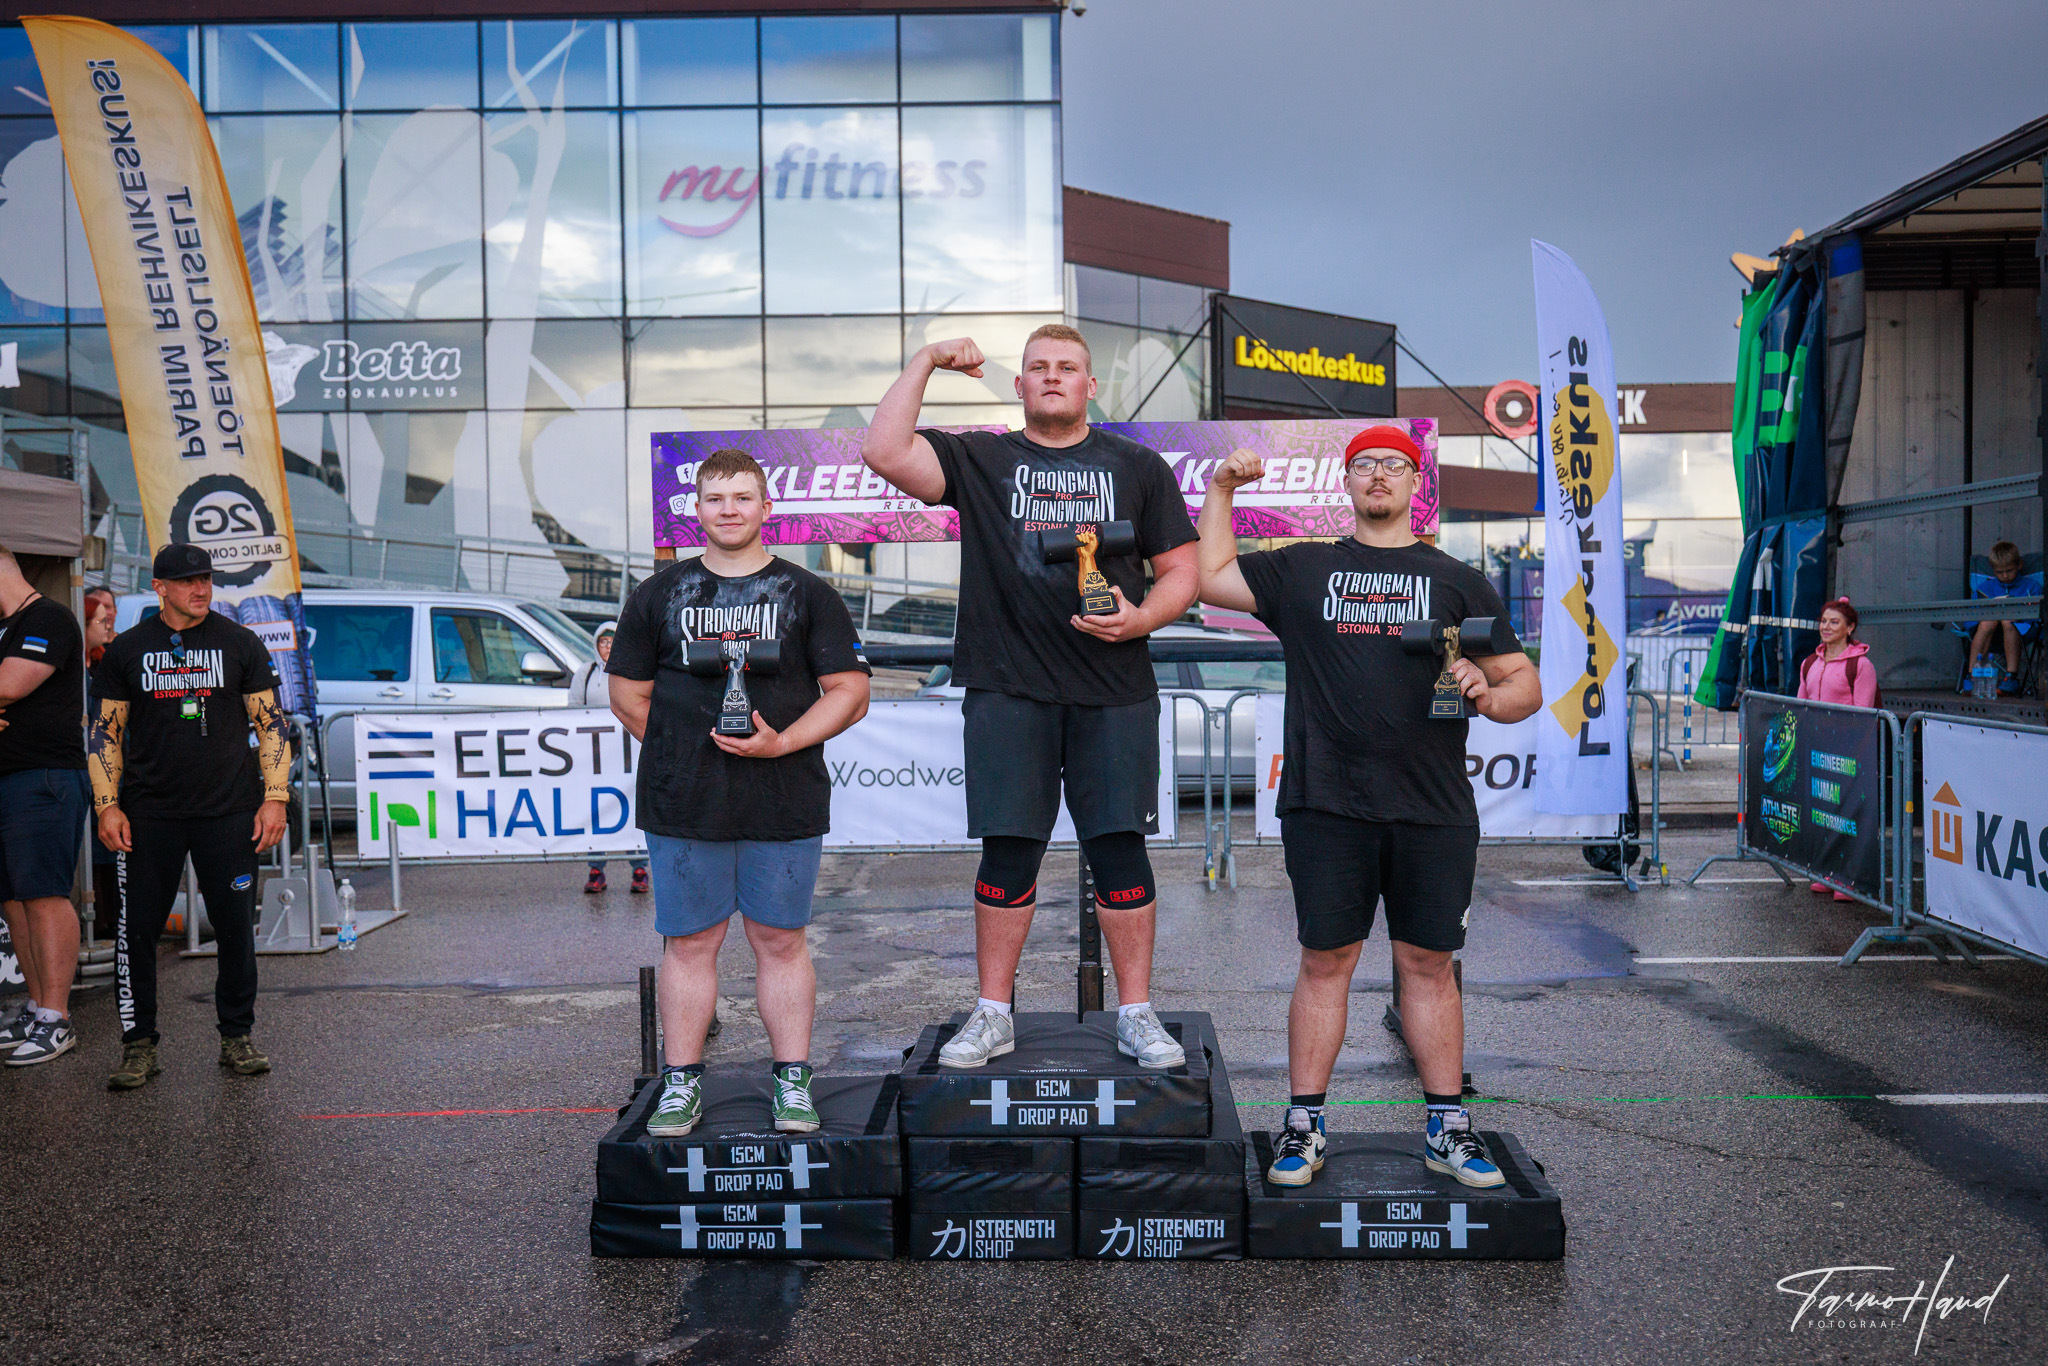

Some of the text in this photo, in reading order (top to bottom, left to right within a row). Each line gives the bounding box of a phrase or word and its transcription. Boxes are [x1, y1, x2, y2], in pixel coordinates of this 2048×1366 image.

[319, 339, 462, 382] Betta
[322, 386, 458, 400] ZOOKAUPLUS
[764, 464, 908, 500] KLEEB
[1055, 492, 1073, 501] PRO
[1010, 494, 1115, 522] STRONGWOMAN
[1074, 523, 1097, 534] 2026
[1367, 594, 1385, 603] PRO
[721, 631, 736, 641] PRO
[1337, 622, 1403, 636] ESTONIA 202
[454, 725, 632, 779] EESTI
[1811, 749, 1857, 777] ENGINEERING
[1811, 776, 1841, 805] HUMAN
[1762, 797, 1798, 827] ATHLETE
[1768, 818, 1790, 835] BYTES
[1811, 807, 1857, 837] PERFORMANCE
[976, 881, 1004, 899] SBD
[1111, 887, 1144, 902] SBD
[116, 849, 136, 1033] RMLIFTING ESTONIA
[1035, 1079, 1071, 1098] 15CM
[1018, 1108, 1088, 1126] DROP PAD
[730, 1145, 765, 1164] 15CM
[714, 1173, 784, 1192] DROP PAD
[723, 1204, 758, 1222] 15CM
[1386, 1202, 1422, 1221] 15CM
[975, 1219, 1056, 1239] STRENGTH
[1144, 1218, 1225, 1239] STRENGTH
[707, 1231, 776, 1250] DROP PAD
[975, 1239, 1014, 1259] SHOP
[1143, 1239, 1183, 1258] SHOP
[1368, 1230, 1440, 1249] DROP PAD
